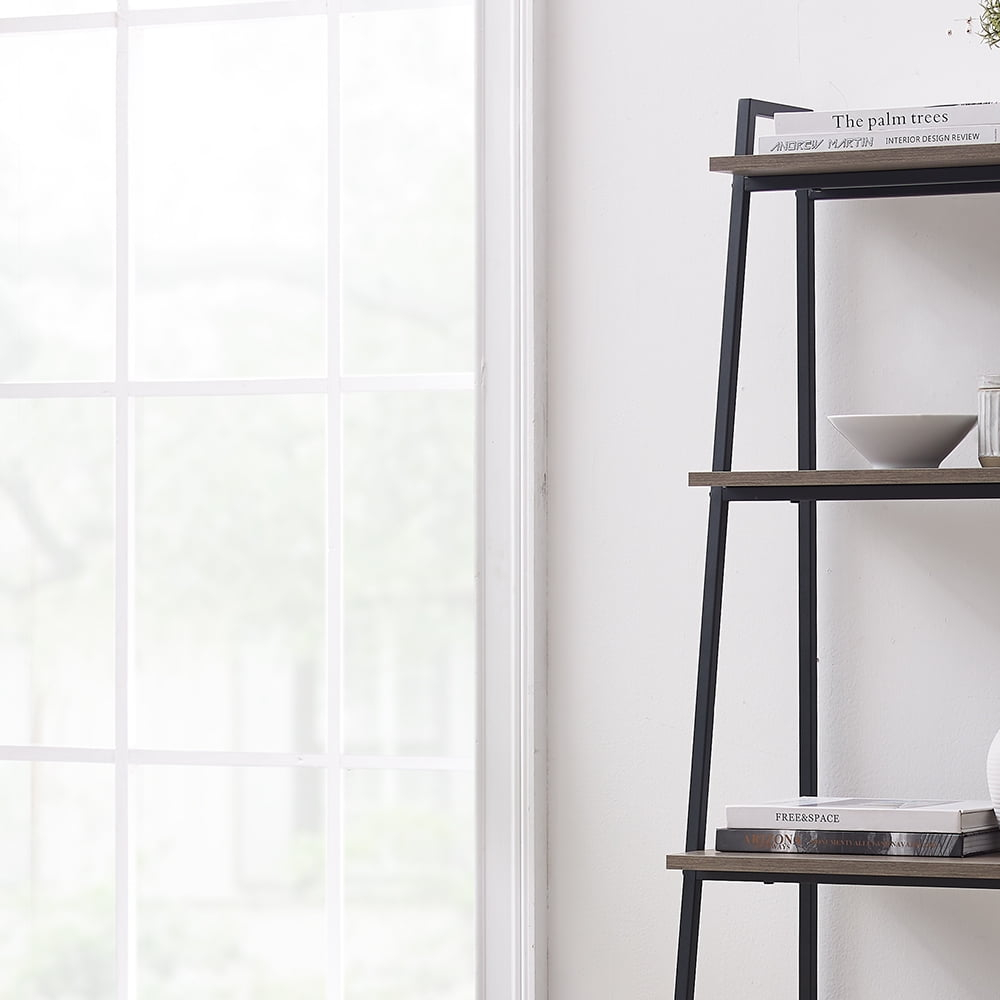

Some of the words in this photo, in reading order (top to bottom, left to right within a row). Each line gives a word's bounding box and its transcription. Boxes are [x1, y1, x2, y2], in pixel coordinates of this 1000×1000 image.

[832, 114, 863, 128] The
[868, 112, 906, 130] palm
[911, 112, 949, 124] trees
[770, 139, 824, 152] ANDREW
[828, 136, 874, 149] MARTIN
[885, 135, 920, 145] INTERIOR
[922, 134, 950, 143] DESIGN
[951, 132, 980, 142] REVIEW
[775, 812, 841, 824] FREE&SPACE
